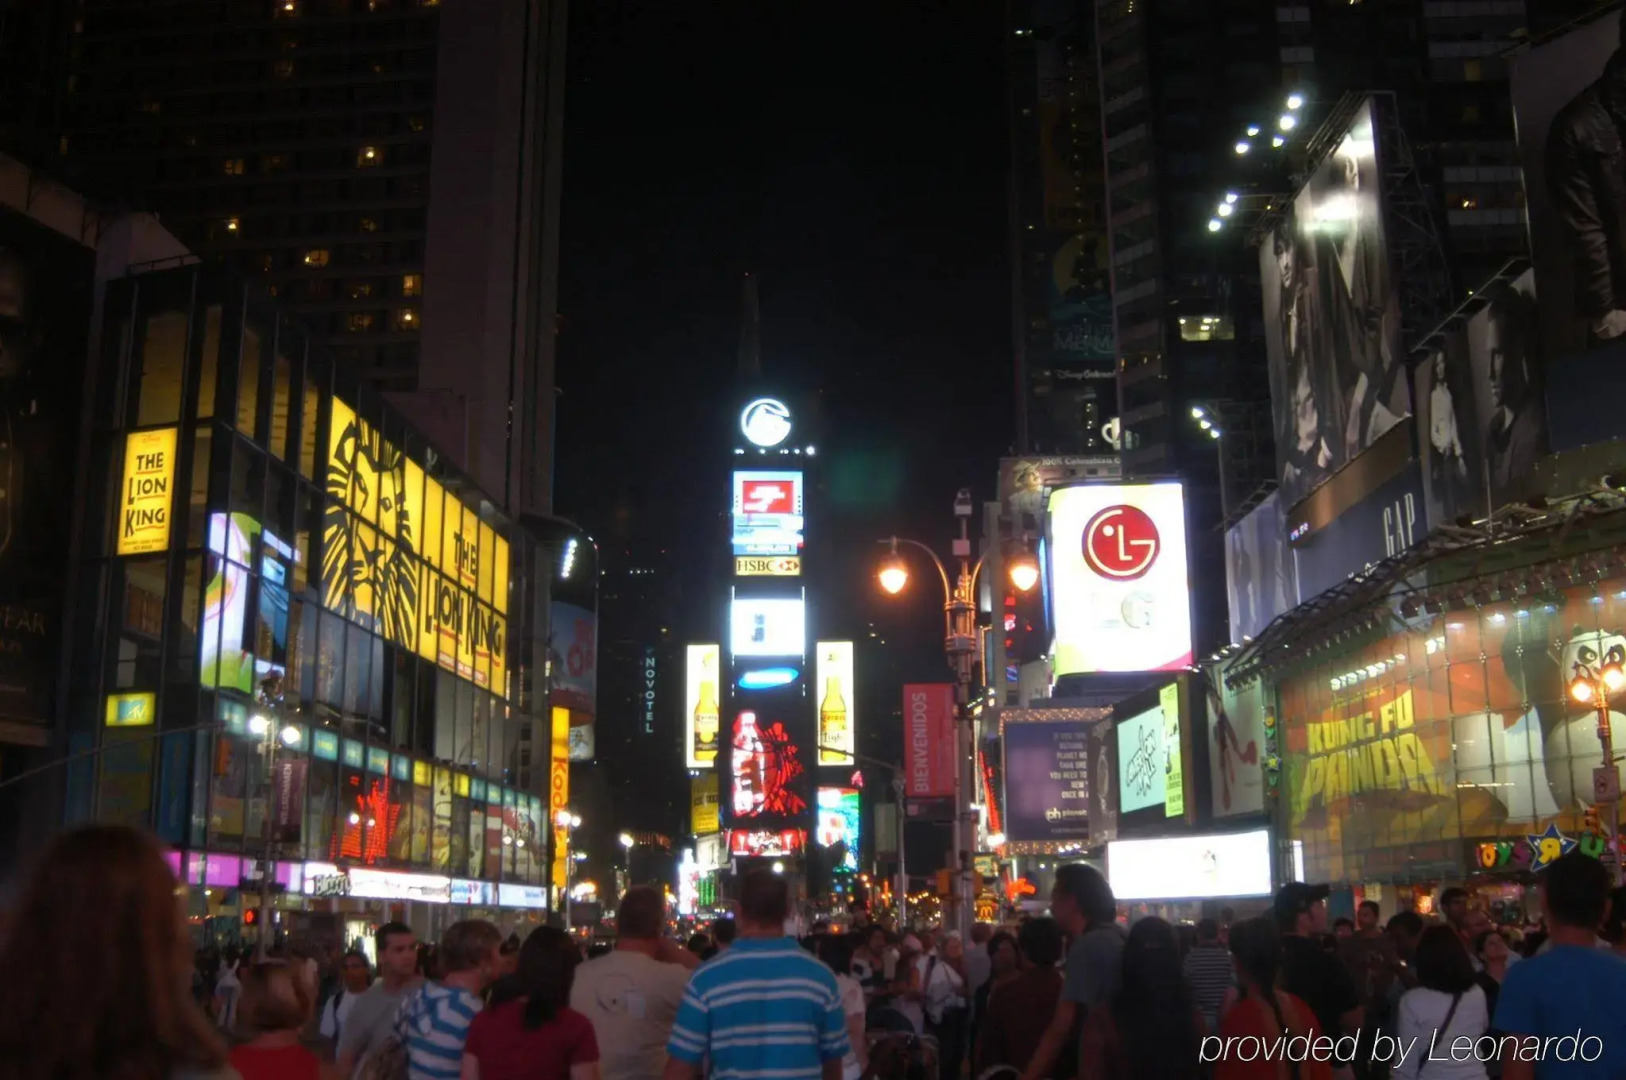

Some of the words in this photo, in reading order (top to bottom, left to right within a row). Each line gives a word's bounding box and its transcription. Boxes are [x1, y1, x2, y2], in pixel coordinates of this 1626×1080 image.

[127, 477, 167, 505] LION
[136, 452, 164, 471] THE
[124, 508, 165, 538] KING
[454, 531, 478, 577] THE
[1087, 508, 1156, 577] LG
[1384, 492, 1415, 558] GAP
[737, 559, 776, 572] HSBC
[424, 556, 463, 635] LION
[465, 586, 502, 657] KING
[645, 657, 656, 734] NOVOTEL
[1307, 711, 1376, 756] KUNG
[1380, 688, 1415, 735] FU
[911, 691, 930, 794] BIENVENIDOS
[1300, 732, 1447, 814] PANDA
